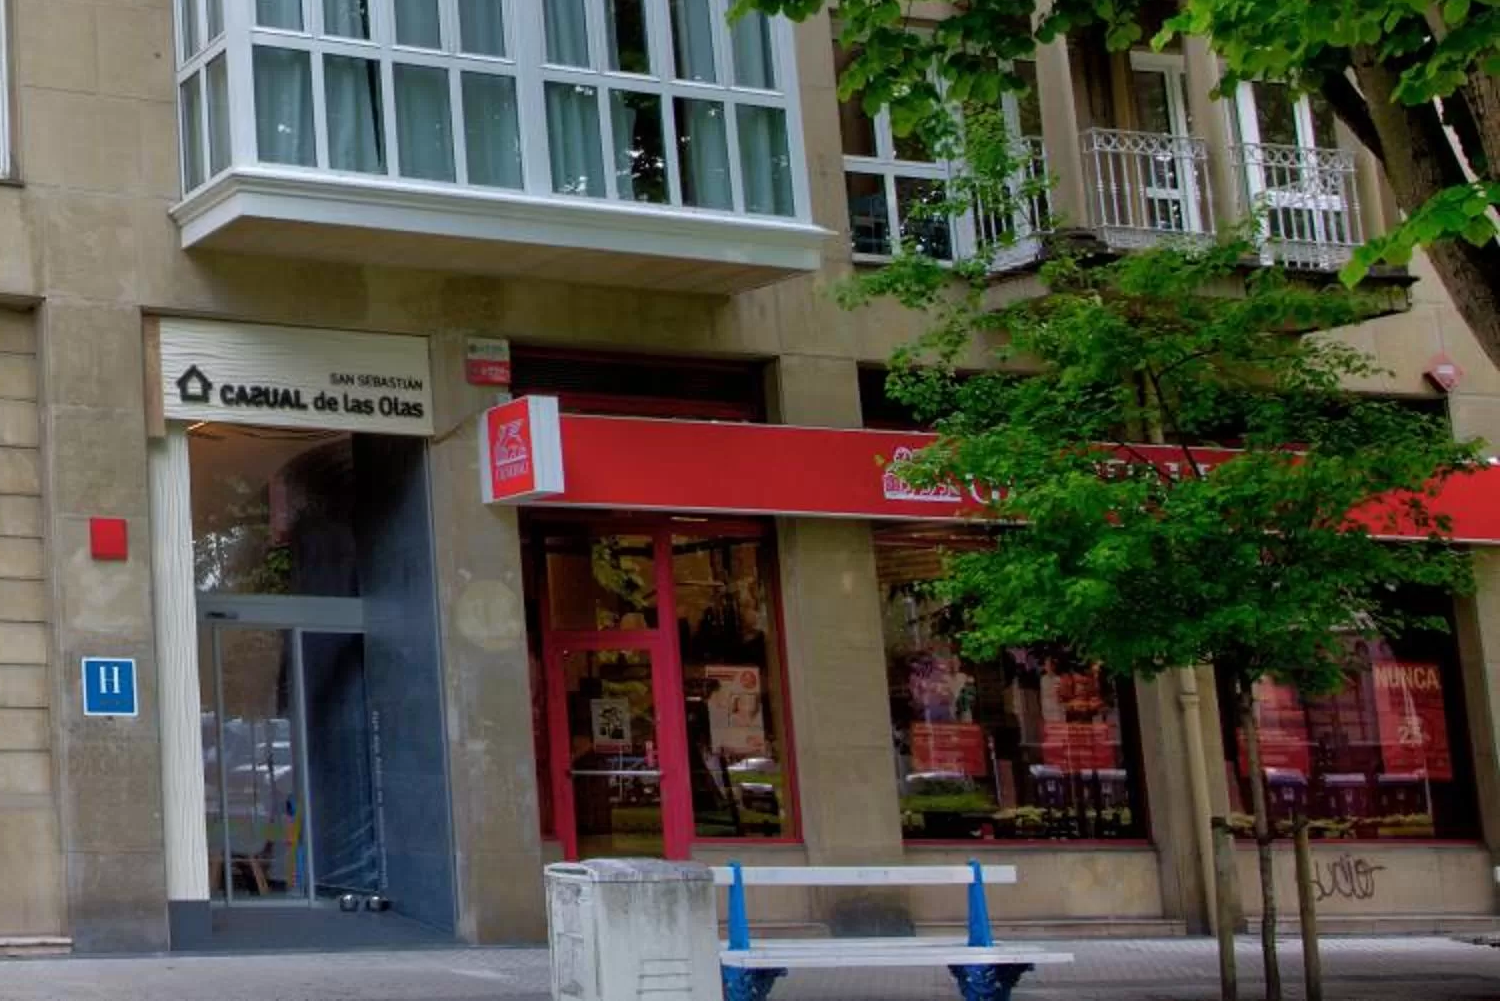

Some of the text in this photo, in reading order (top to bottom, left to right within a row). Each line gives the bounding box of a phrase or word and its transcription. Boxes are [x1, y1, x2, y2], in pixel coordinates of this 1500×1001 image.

[330, 373, 355, 386] SAN
[313, 390, 339, 412] de
[343, 390, 375, 415] las
[378, 395, 424, 419] Olas
[99, 666, 121, 695] H
